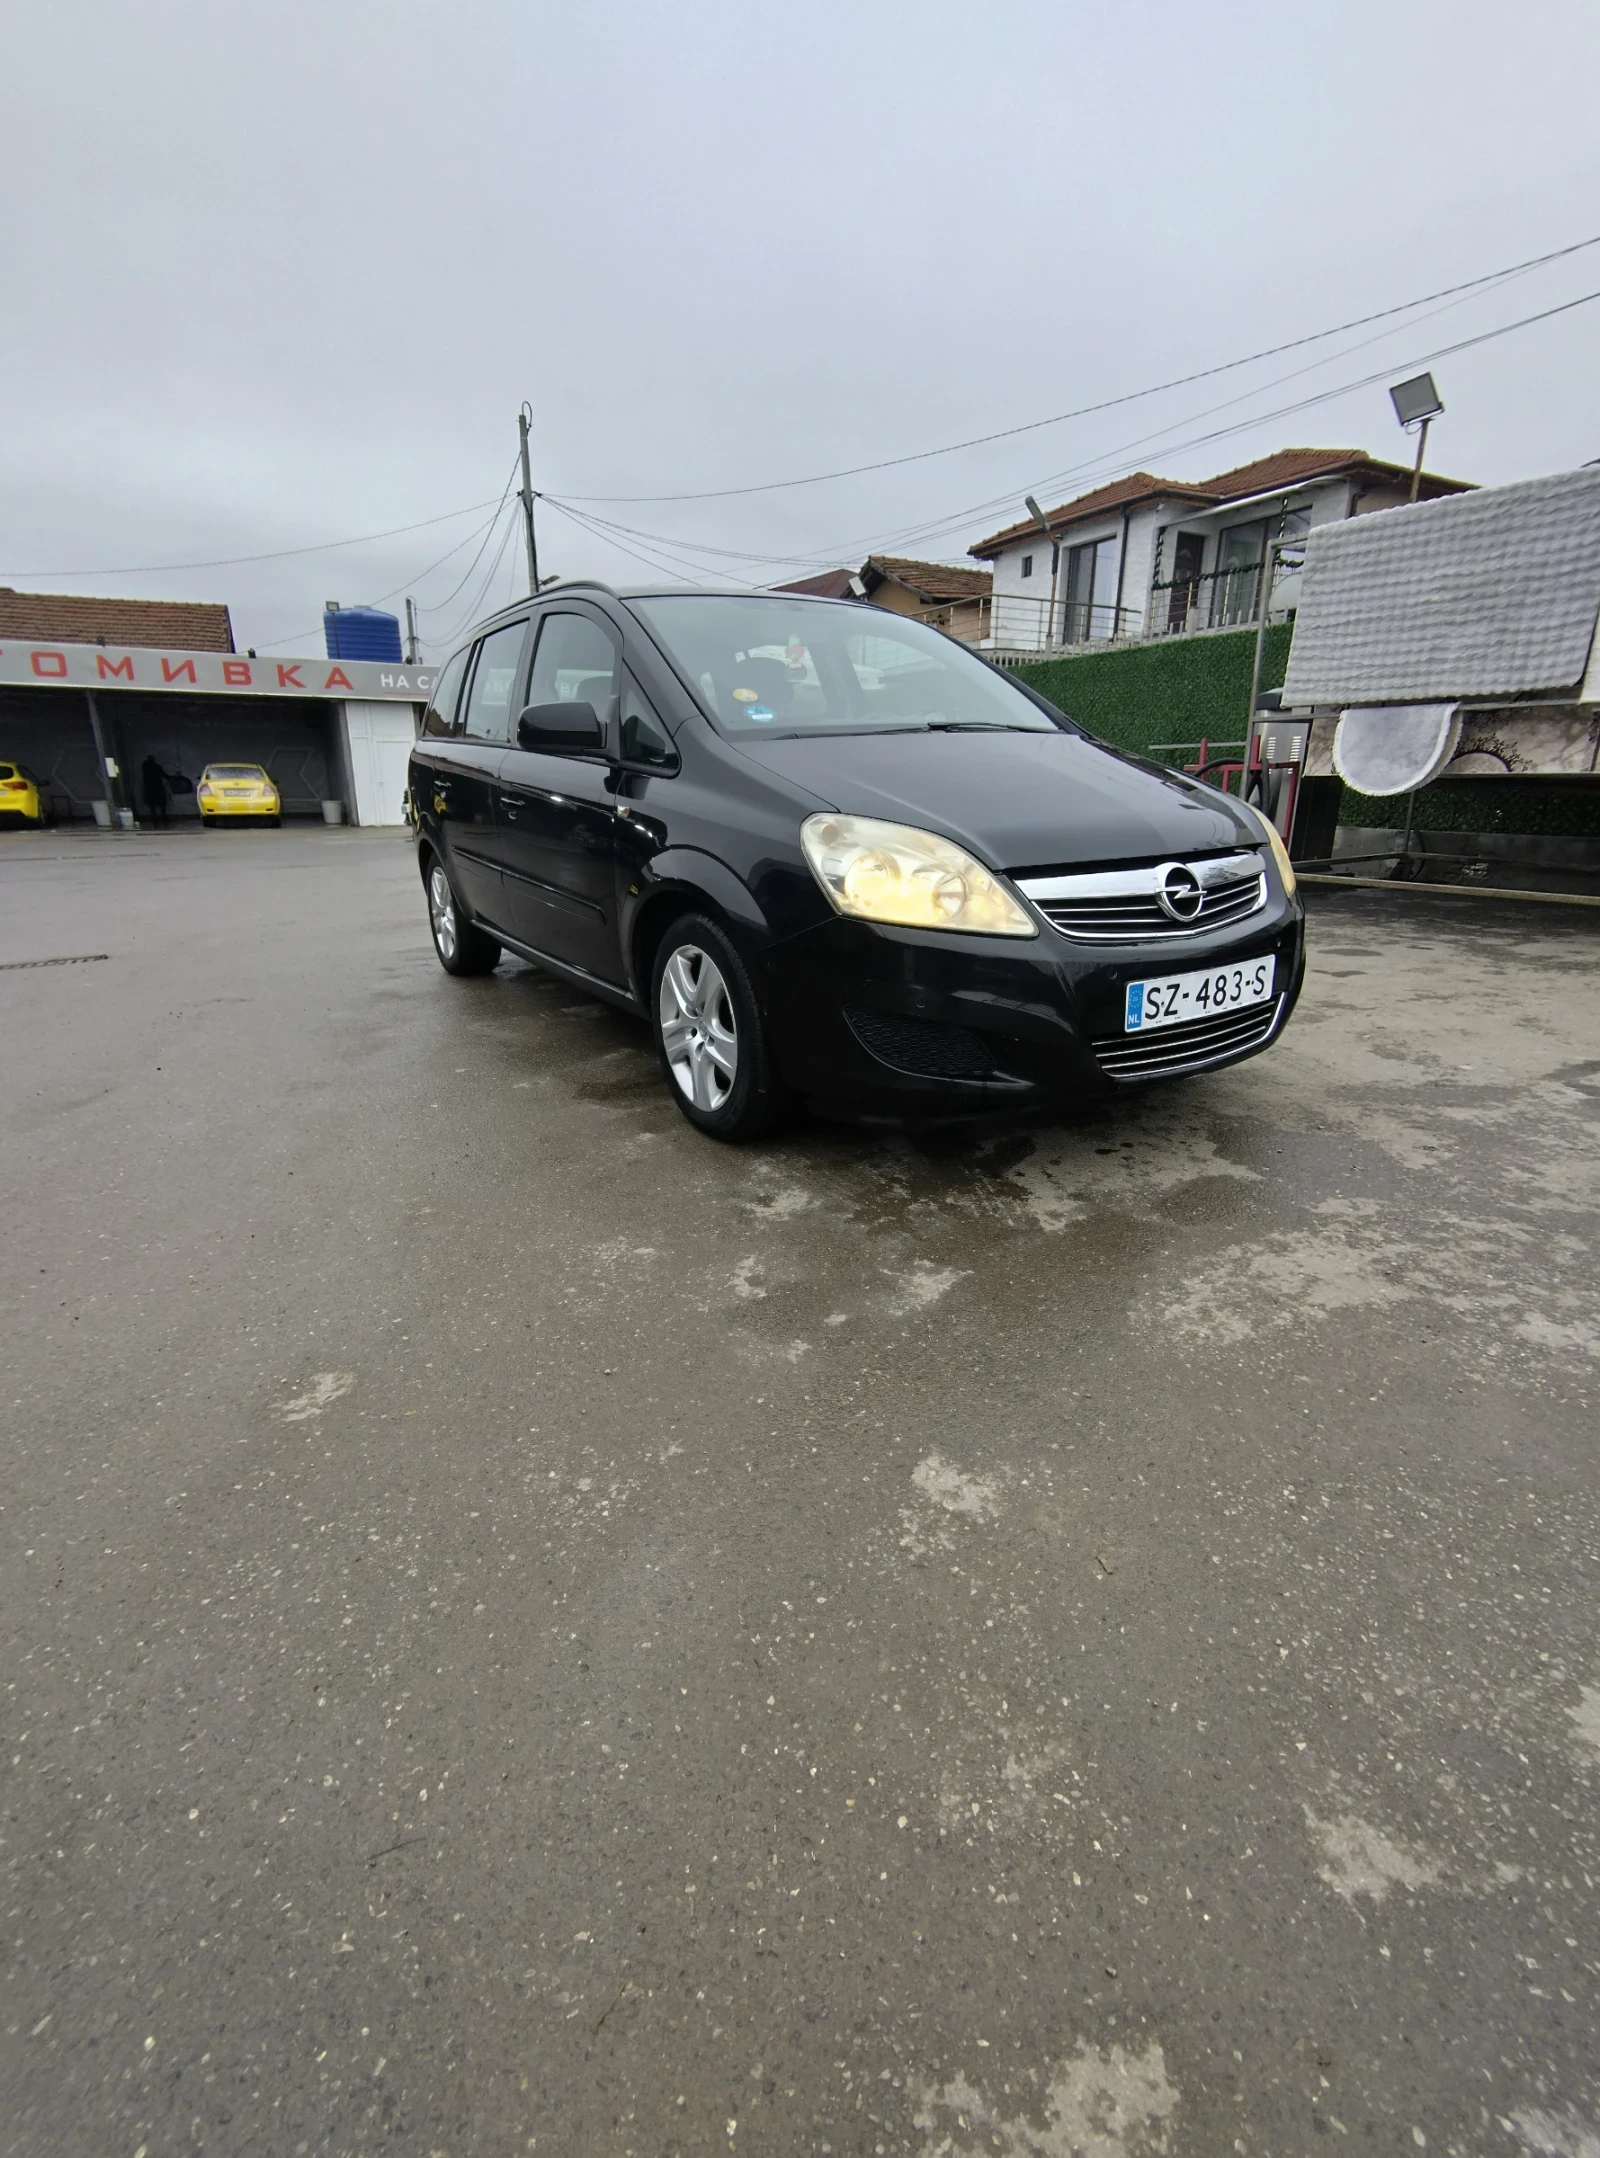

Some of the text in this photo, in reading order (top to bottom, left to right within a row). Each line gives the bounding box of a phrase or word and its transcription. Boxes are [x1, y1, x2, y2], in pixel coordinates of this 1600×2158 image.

[0, 649, 354, 690] ОМИВКА
[380, 673, 410, 689] НА
[1144, 965, 1267, 1020] SZ-483-S
[1128, 1014, 1140, 1025] NL
